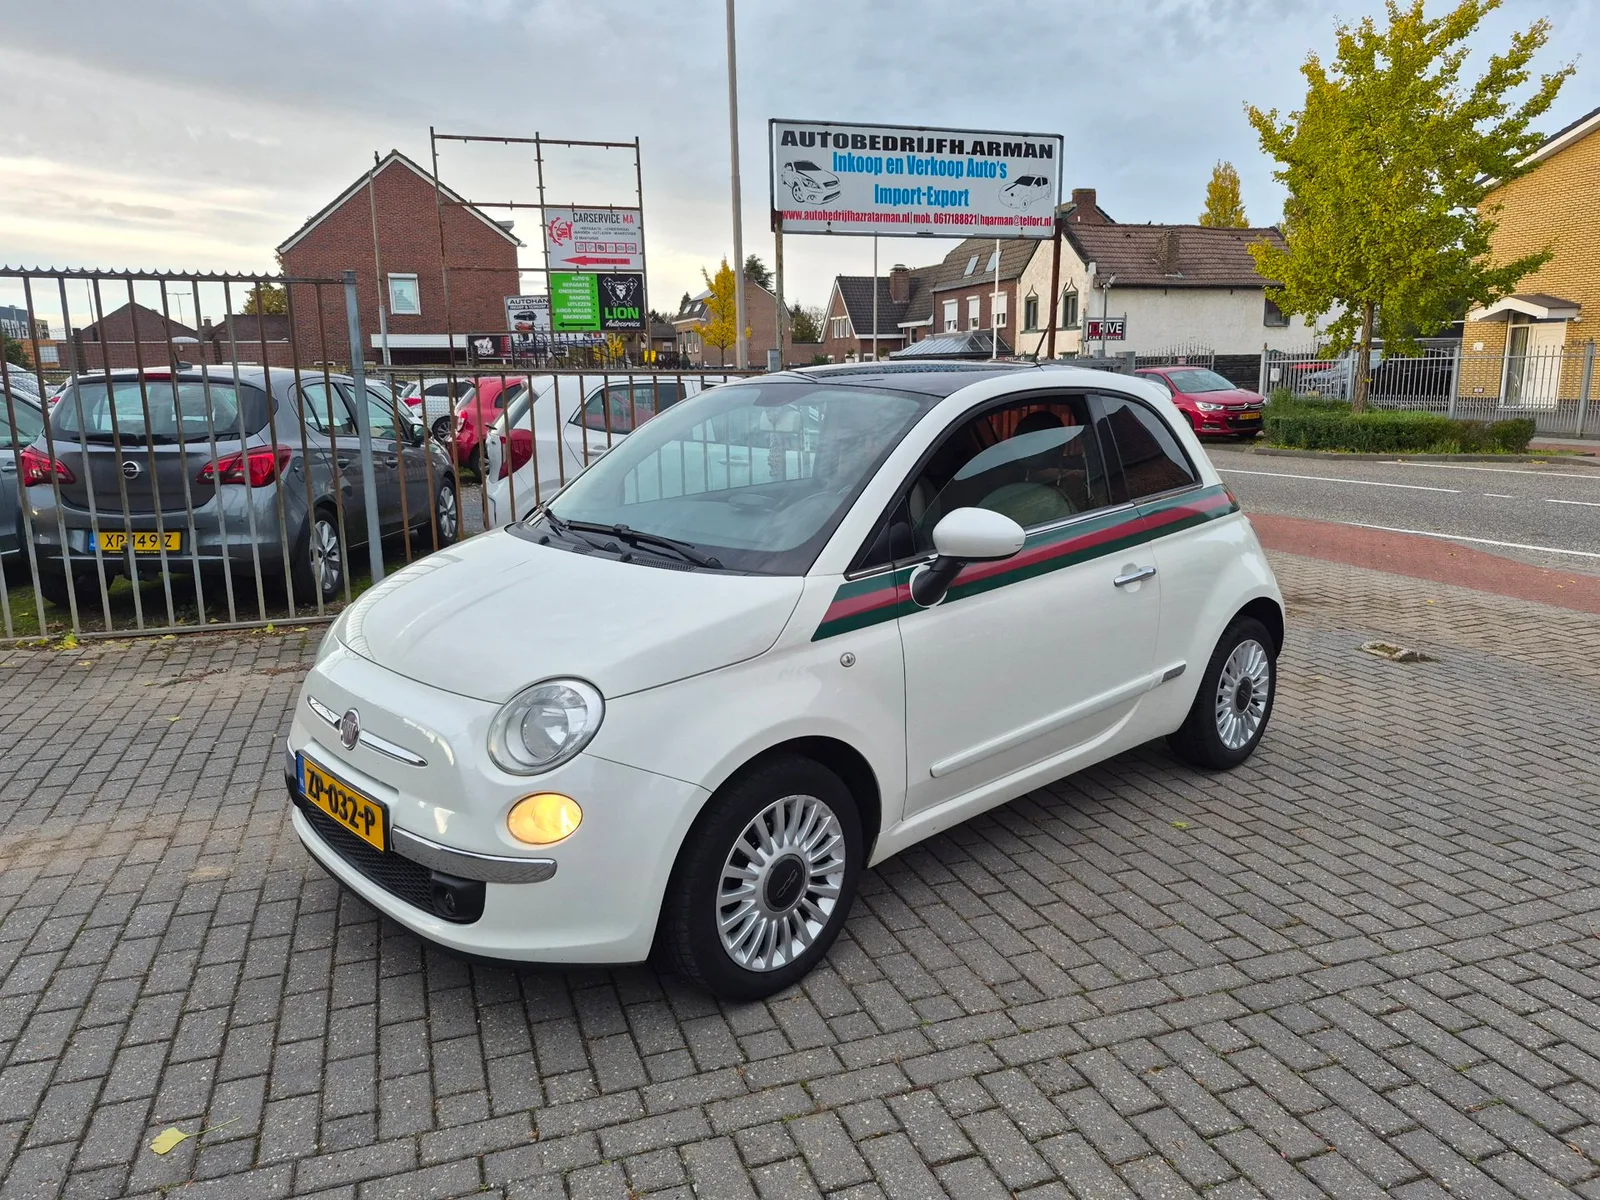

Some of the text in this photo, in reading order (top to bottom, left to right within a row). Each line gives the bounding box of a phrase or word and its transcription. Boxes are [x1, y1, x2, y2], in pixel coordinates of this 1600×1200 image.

[833, 151, 1007, 179] Inkoop en Verkoop Auto's
[874, 183, 970, 208] Import-Export
[573, 212, 635, 224] CARSERVICE MA
[604, 307, 640, 319] LION
[605, 319, 641, 327] Autoservice
[105, 534, 172, 548] XP149Z
[306, 767, 376, 836] ZP-032-P
